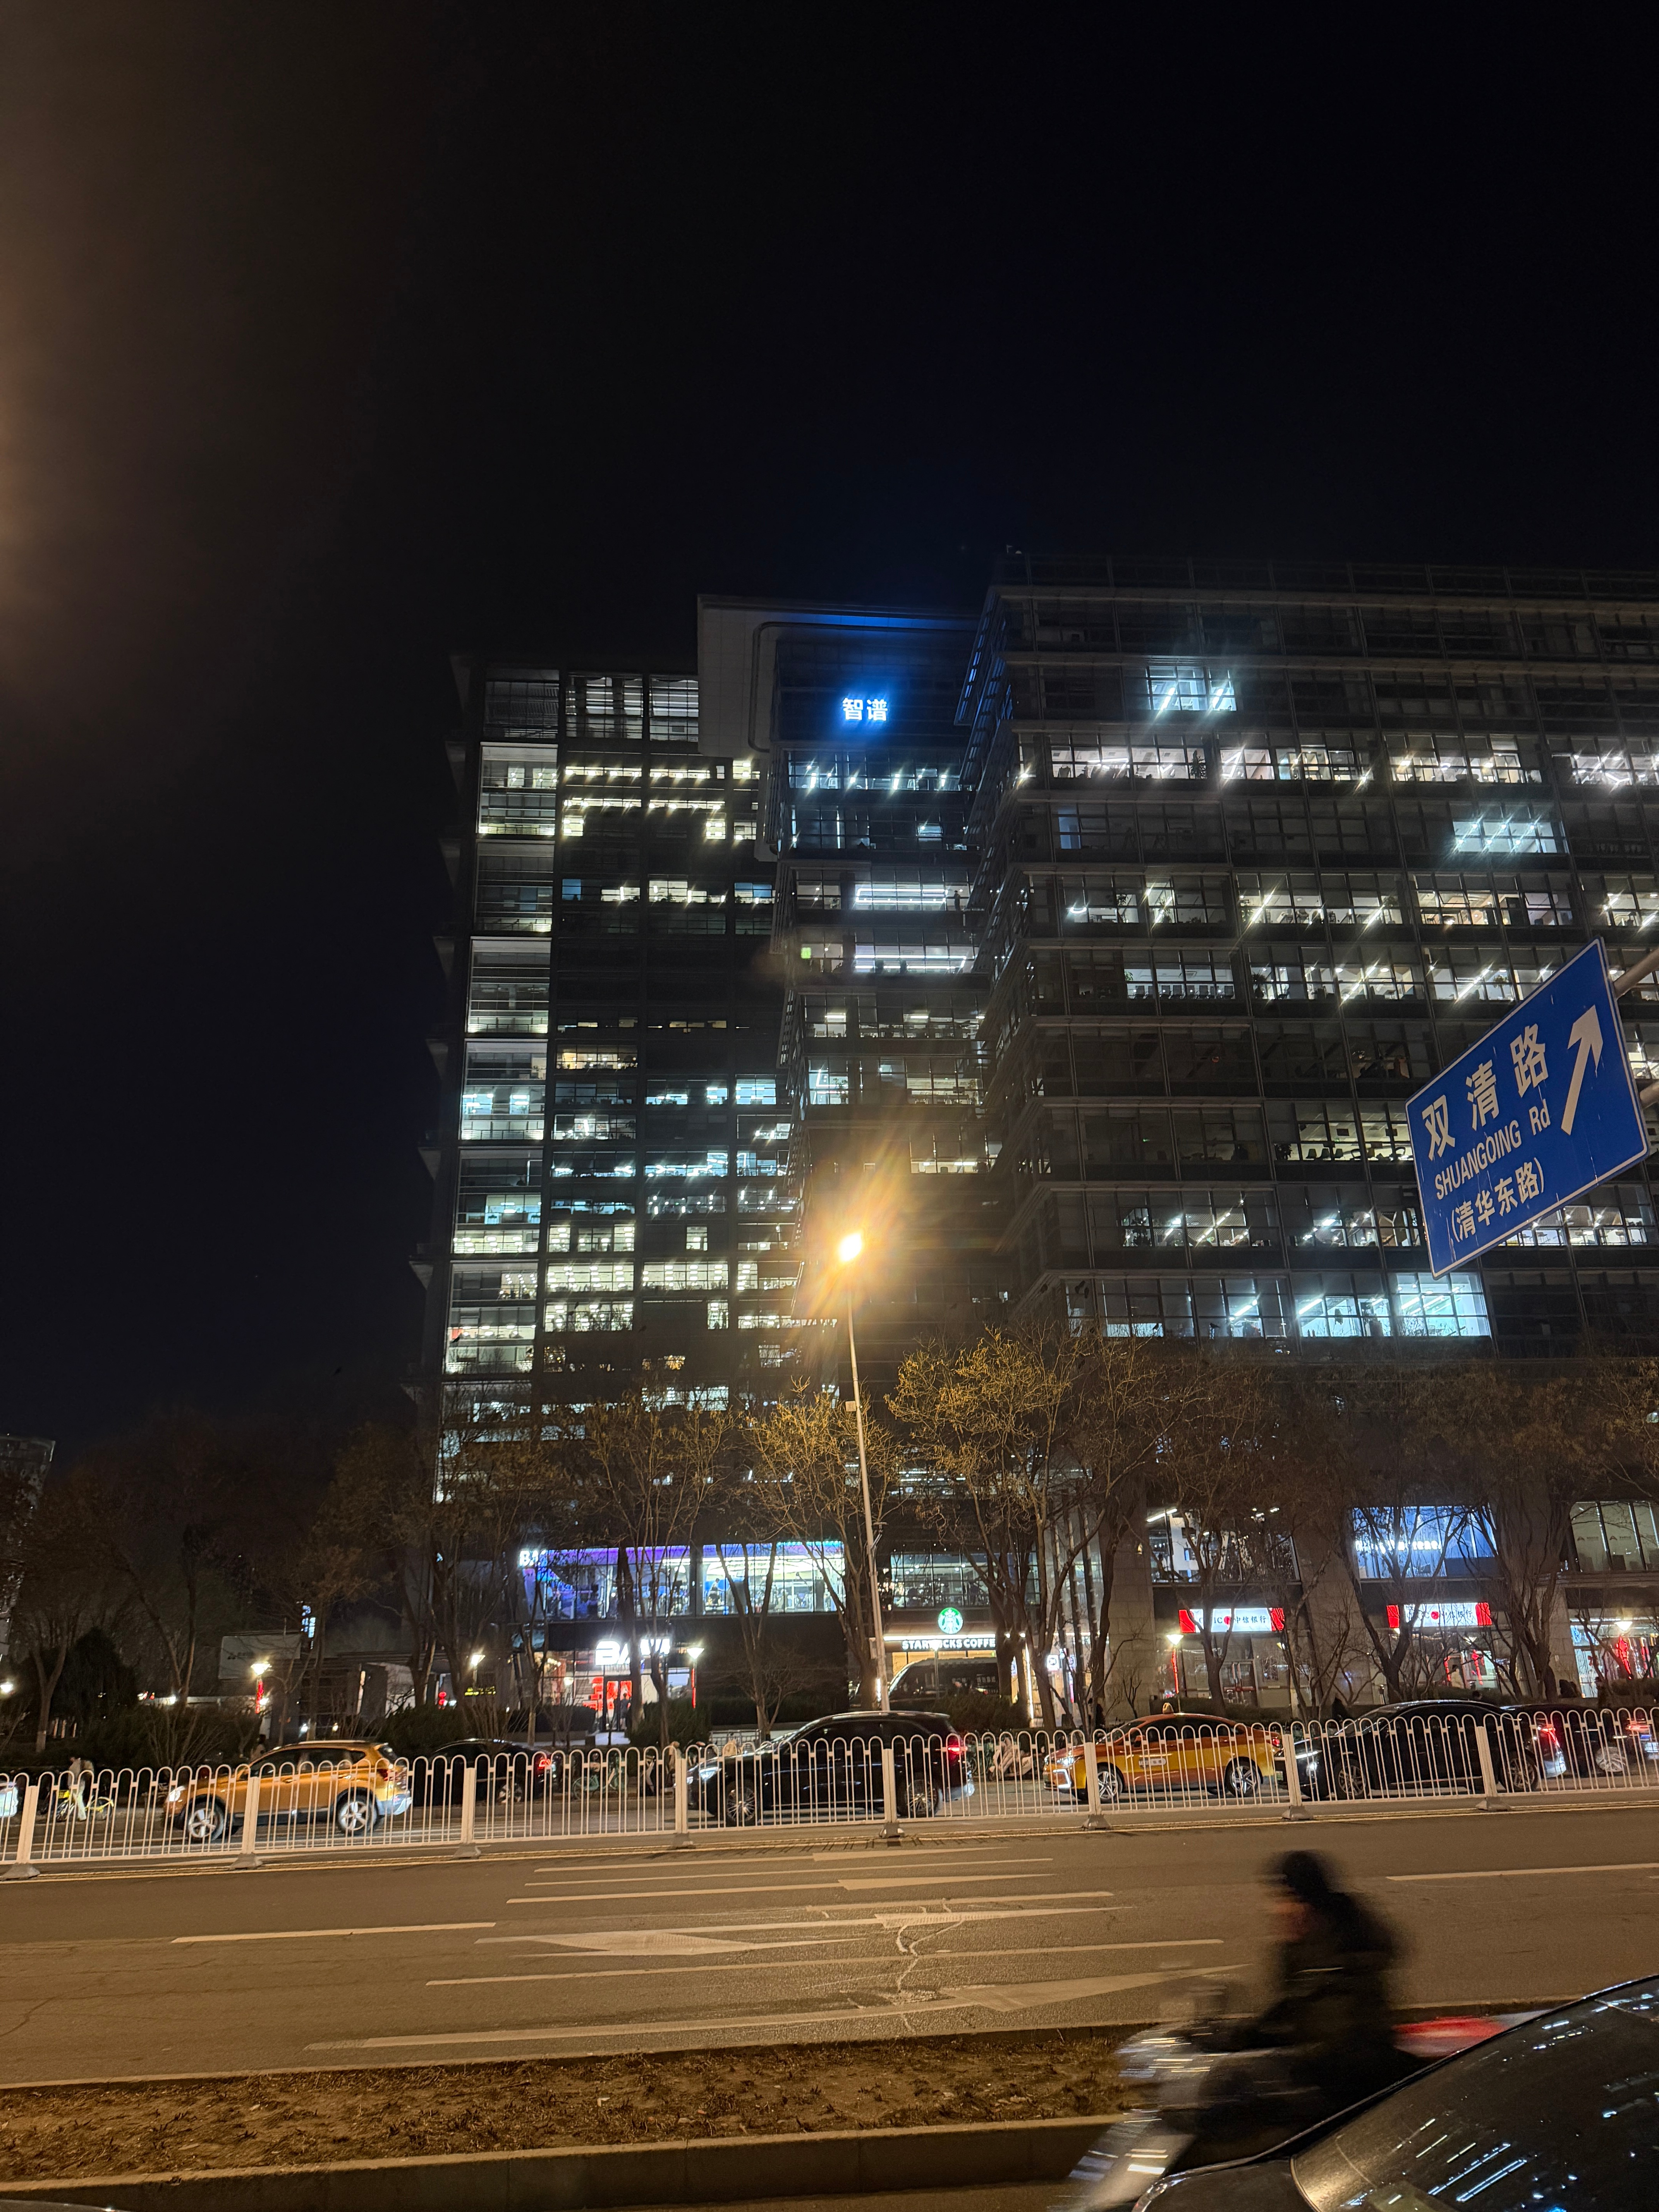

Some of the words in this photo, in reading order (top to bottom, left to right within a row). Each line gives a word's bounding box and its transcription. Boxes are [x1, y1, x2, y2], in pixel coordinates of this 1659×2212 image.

[842, 697, 888, 721] 智谱
[1422, 1024, 1549, 1161] 双清路
[1435, 1120, 1522, 1200] SHUANGQING
[1529, 1099, 1551, 1135] Rd
[1451, 1158, 1544, 1242] (清华东路)
[902, 1639, 962, 1650] STARCKS
[963, 1638, 996, 1648] COFFE
